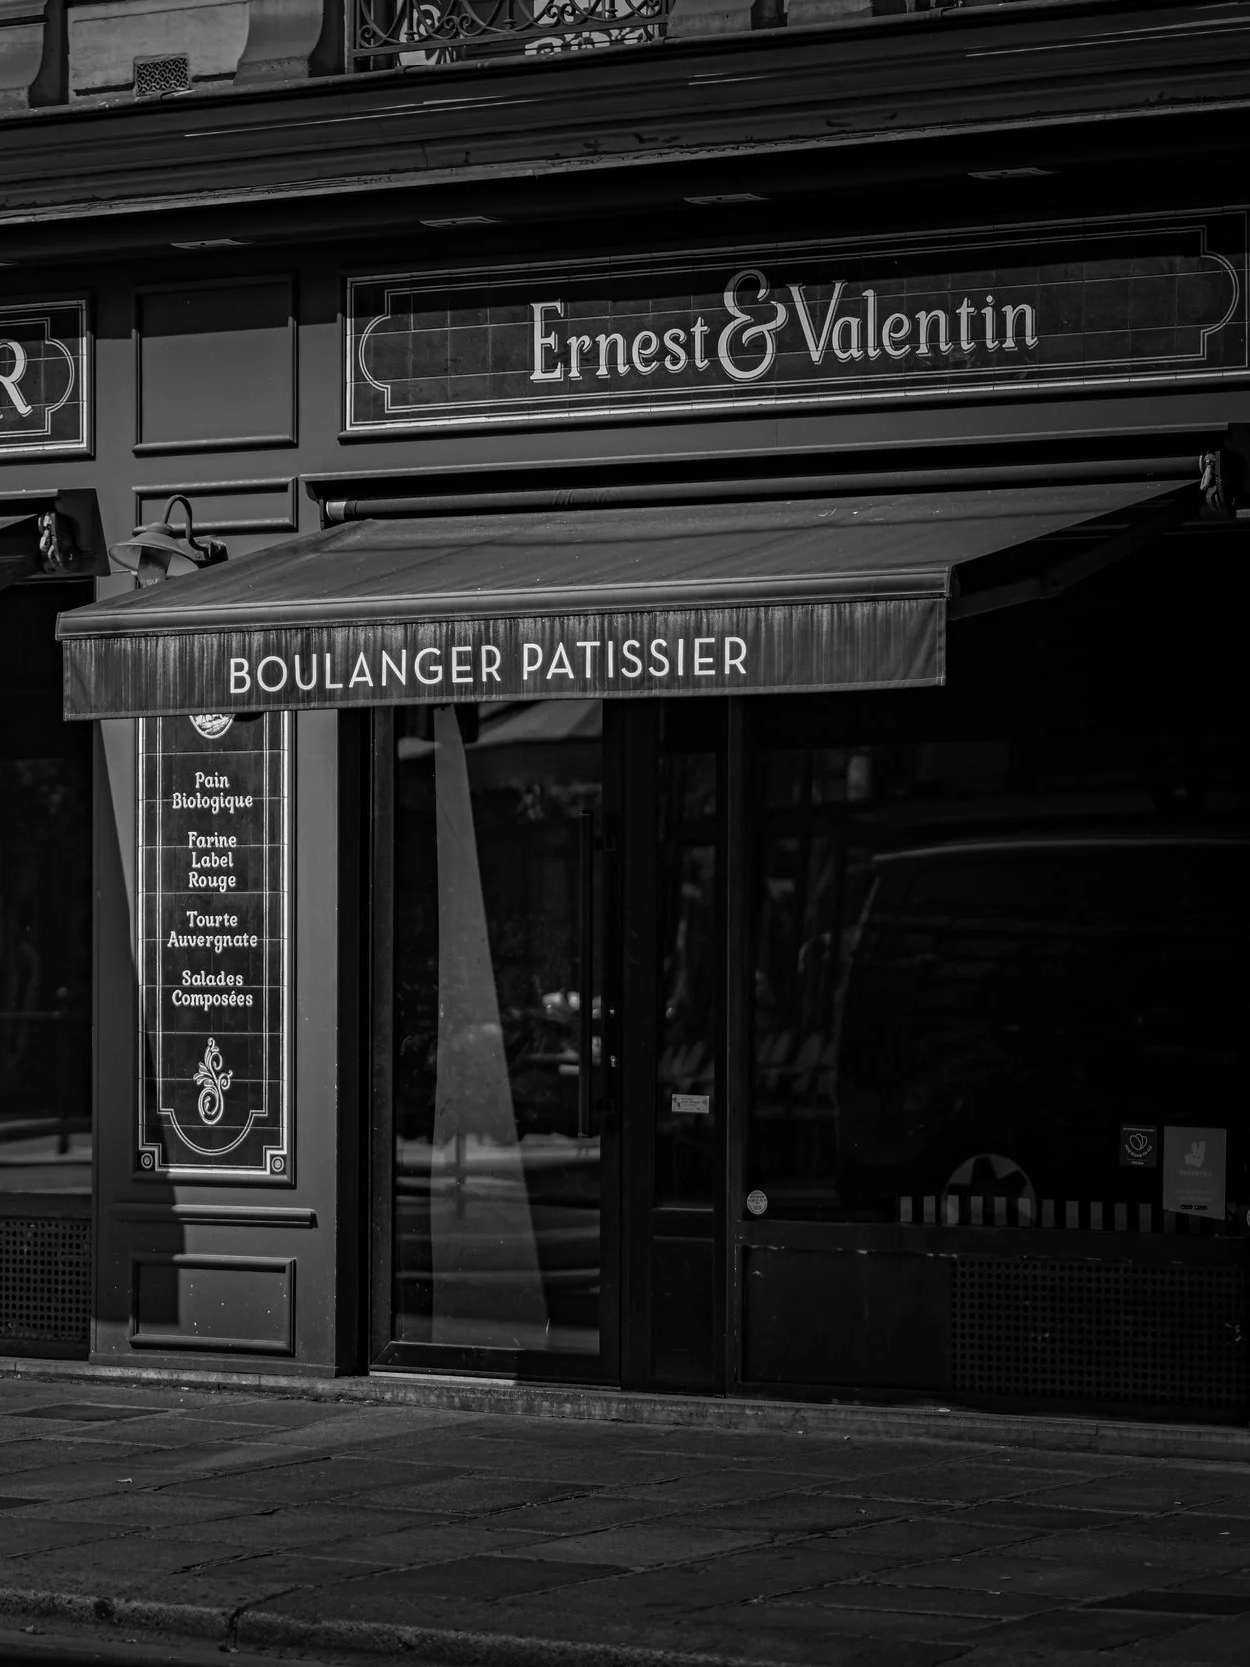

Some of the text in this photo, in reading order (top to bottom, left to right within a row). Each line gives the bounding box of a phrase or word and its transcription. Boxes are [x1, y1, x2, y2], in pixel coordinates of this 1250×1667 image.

[529, 269, 1039, 384] Ernest & Valentin
[229, 636, 748, 694] BOULANGER PATISSIER
[195, 771, 230, 789] Pain
[172, 792, 253, 814] Biologique
[187, 831, 237, 849] Farine
[191, 851, 234, 869] Label
[188, 871, 237, 893] Rouge
[186, 910, 238, 928] Tourte
[167, 930, 258, 954] Auvergnate
[181, 969, 244, 986] Salades
[171, 989, 254, 1012] Composées
